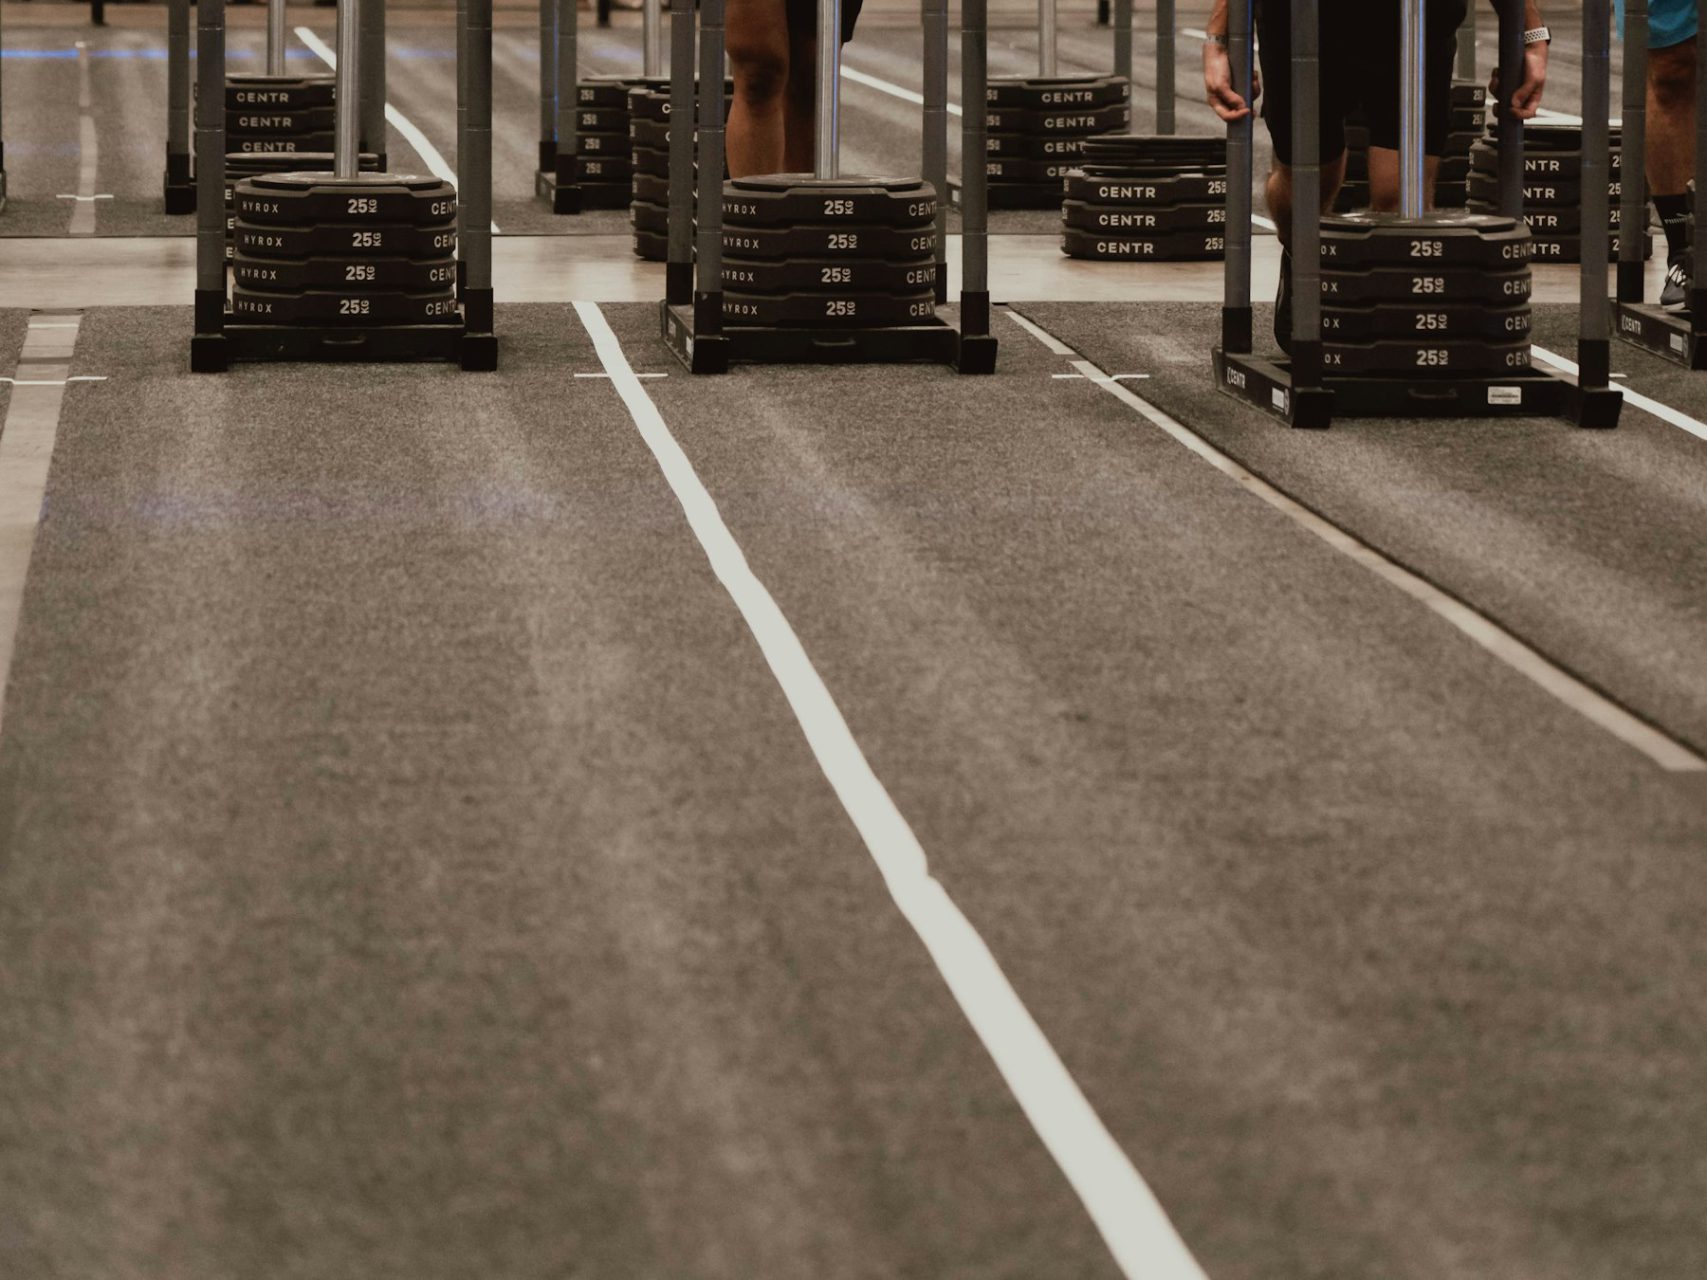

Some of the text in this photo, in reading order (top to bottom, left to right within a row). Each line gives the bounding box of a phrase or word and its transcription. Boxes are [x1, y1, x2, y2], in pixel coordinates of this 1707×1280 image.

[236, 92, 289, 102] CENTR
[1041, 92, 1093, 103] CENTR
[239, 117, 292, 127] CENTR
[1044, 116, 1095, 128] CENTR
[1044, 141, 1085, 152] CENT
[1525, 160, 1559, 171] NTR
[1099, 186, 1156, 198] CENTR
[1523, 188, 1555, 198] NTR
[242, 200, 279, 213] HYROX
[1099, 215, 1155, 226] CENTR
[1524, 215, 1557, 226] NTR
[244, 234, 282, 247] HYROX
[723, 237, 759, 249] HYROX
[1097, 242, 1154, 254] CENTR
[241, 268, 276, 280] HYROX
[238, 301, 272, 313] HYROX
